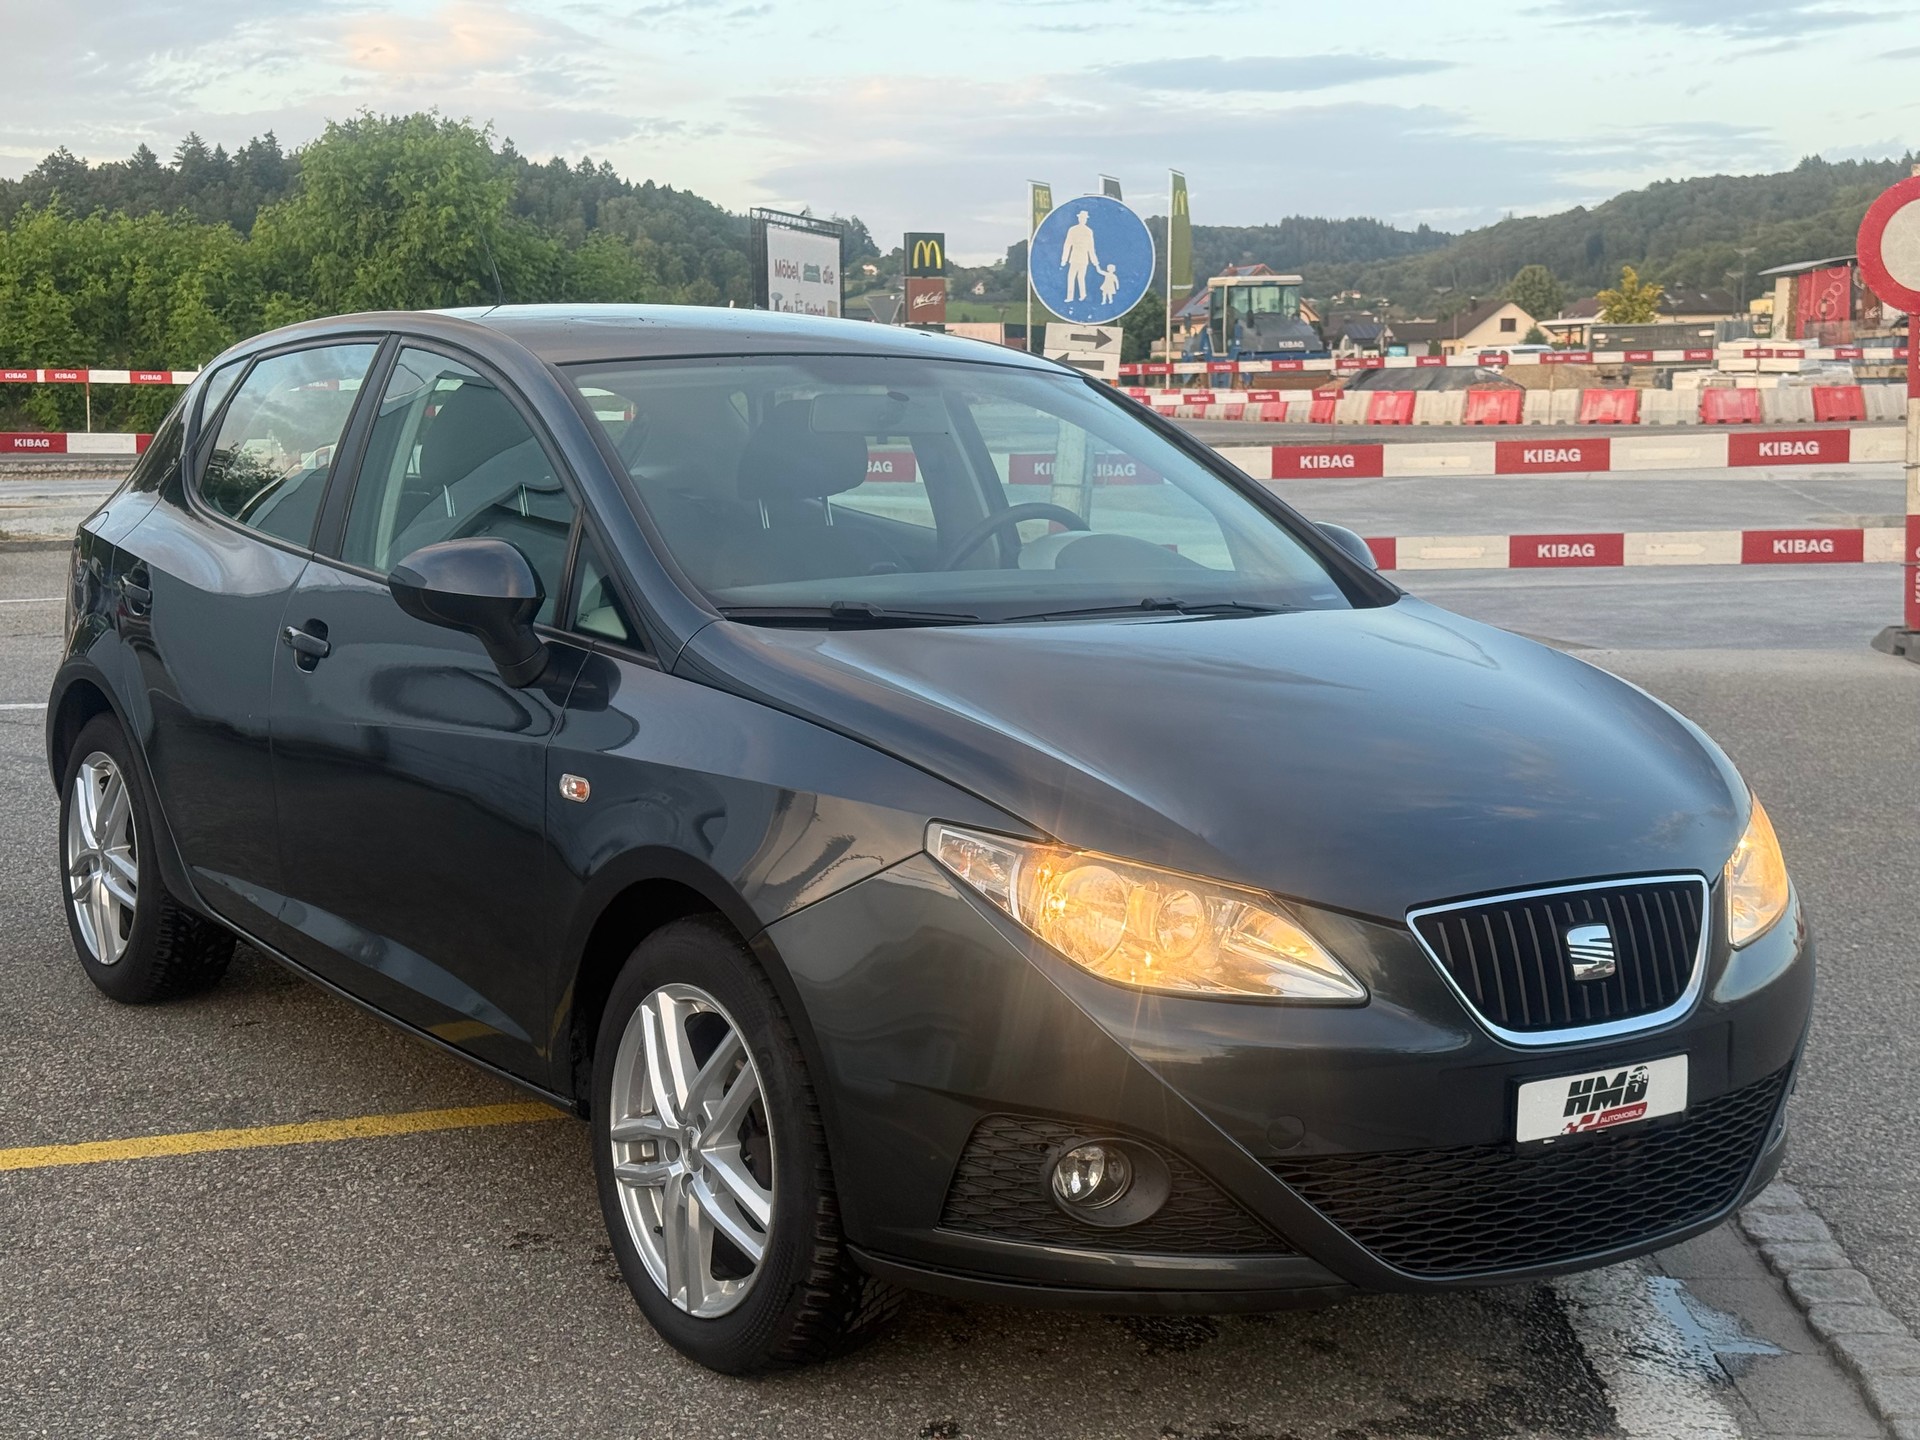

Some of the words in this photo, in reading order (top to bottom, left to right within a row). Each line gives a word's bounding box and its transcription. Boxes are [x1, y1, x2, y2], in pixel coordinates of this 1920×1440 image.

[774, 258, 801, 283] Möbel,
[822, 265, 834, 285] die
[53, 372, 78, 380] KIBAG
[139, 373, 163, 381] KIBAG
[14, 438, 50, 448] KIBAG
[1759, 441, 1820, 456] KIBAG
[1300, 454, 1354, 469] KIBAG
[1523, 448, 1582, 463] KIBAG
[866, 460, 893, 473] BAG
[1093, 462, 1137, 477] IBAG
[1537, 544, 1595, 558] KIBAG
[1773, 539, 1834, 554] KIBAG
[1600, 1108, 1644, 1125] AUTOMOBILE
